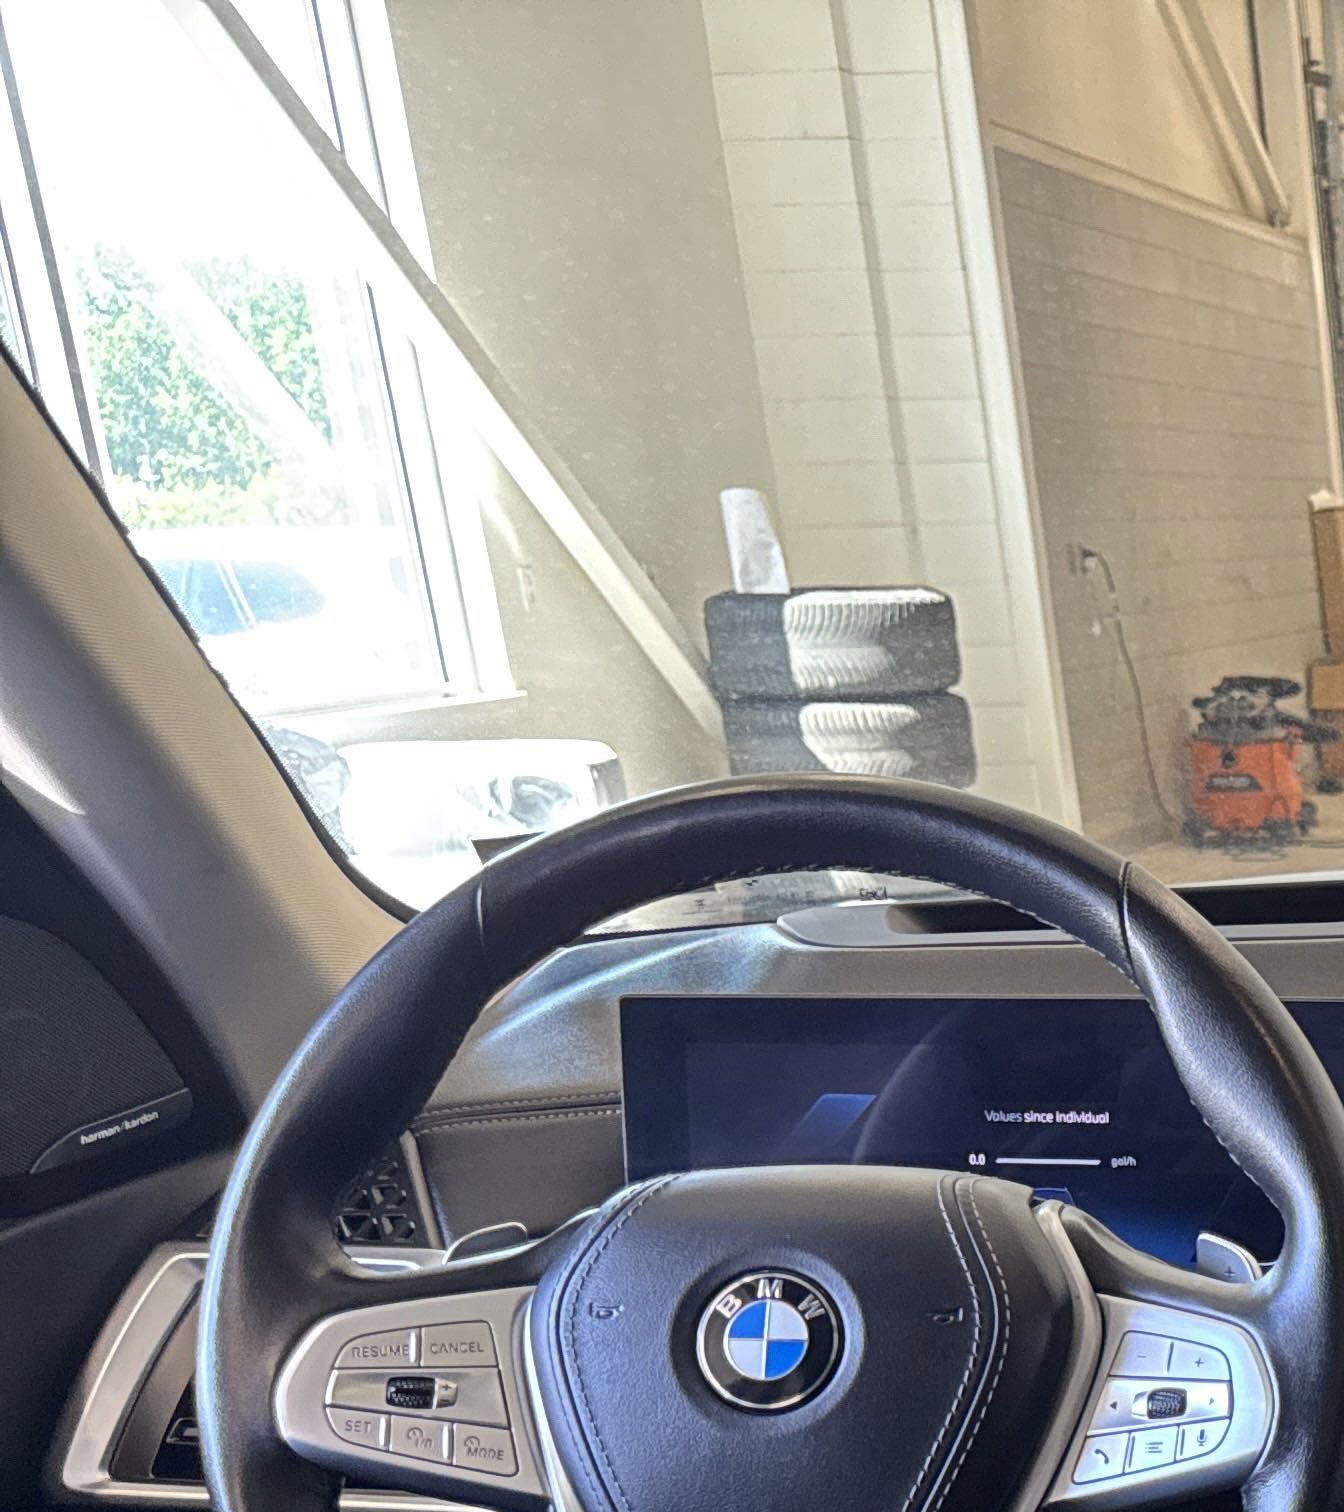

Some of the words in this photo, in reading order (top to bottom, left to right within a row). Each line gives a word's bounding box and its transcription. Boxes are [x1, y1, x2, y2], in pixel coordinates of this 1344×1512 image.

[984, 1110, 1022, 1122] Values
[1024, 1110, 1053, 1122] since
[716, 1278, 825, 1320] BMW
[352, 1344, 410, 1358] RESUME
[430, 1342, 485, 1355] CANCEL
[345, 1420, 372, 1433] SET
[466, 1447, 505, 1460] MODE
